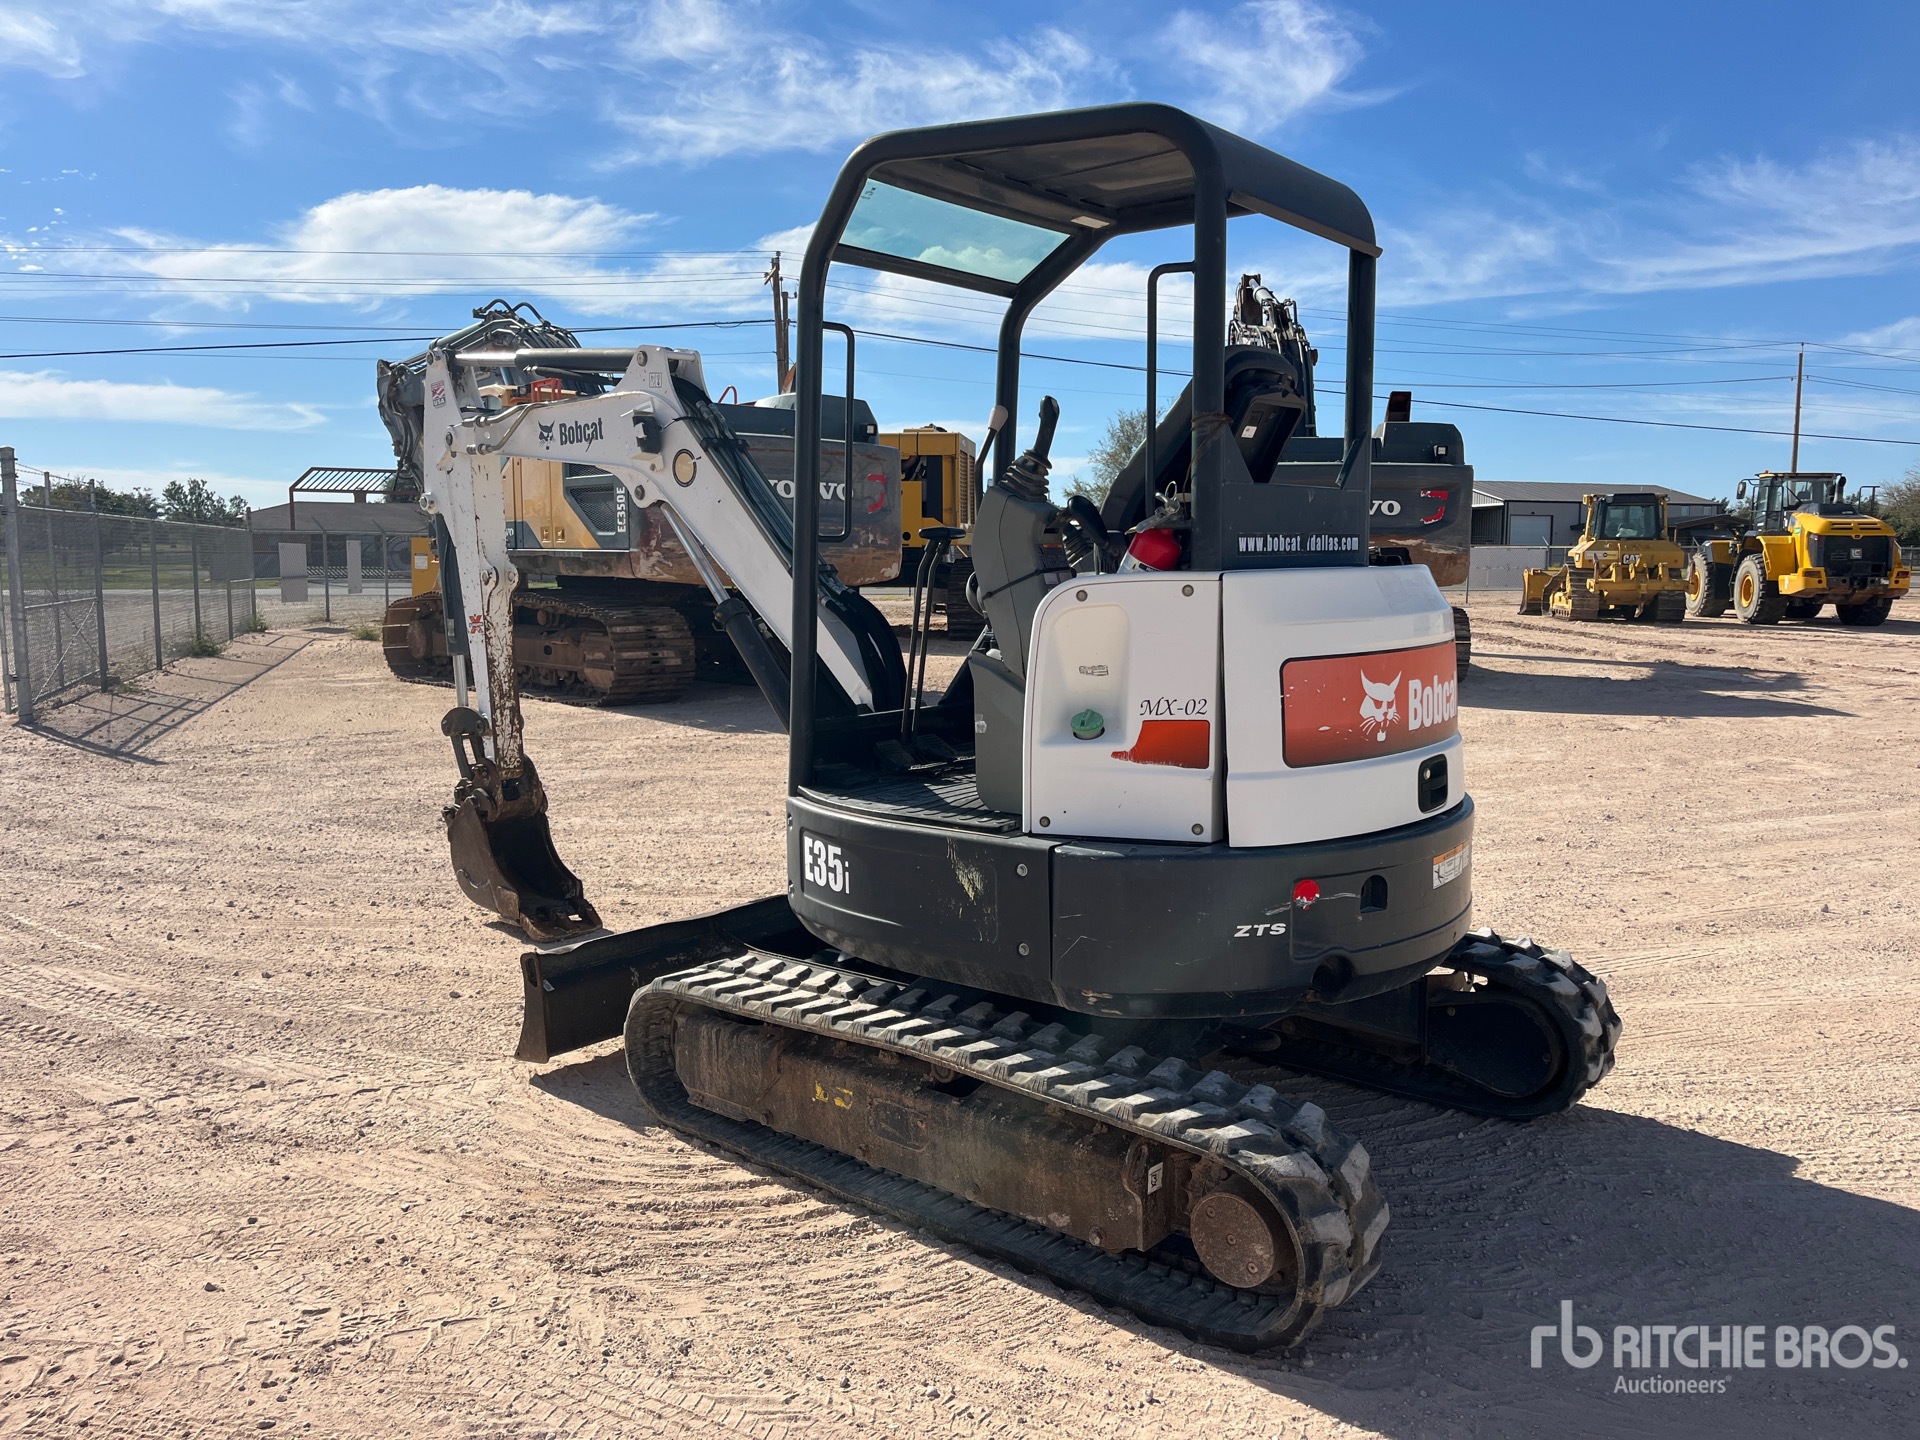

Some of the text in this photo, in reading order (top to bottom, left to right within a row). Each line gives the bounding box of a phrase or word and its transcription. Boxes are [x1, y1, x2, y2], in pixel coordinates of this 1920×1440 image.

[559, 418, 603, 446] Bobcat
[616, 487, 627, 533] EC350E
[1139, 697, 1208, 716] MX-02
[803, 835, 850, 894] E35i
[1233, 923, 1287, 938] ZTS
